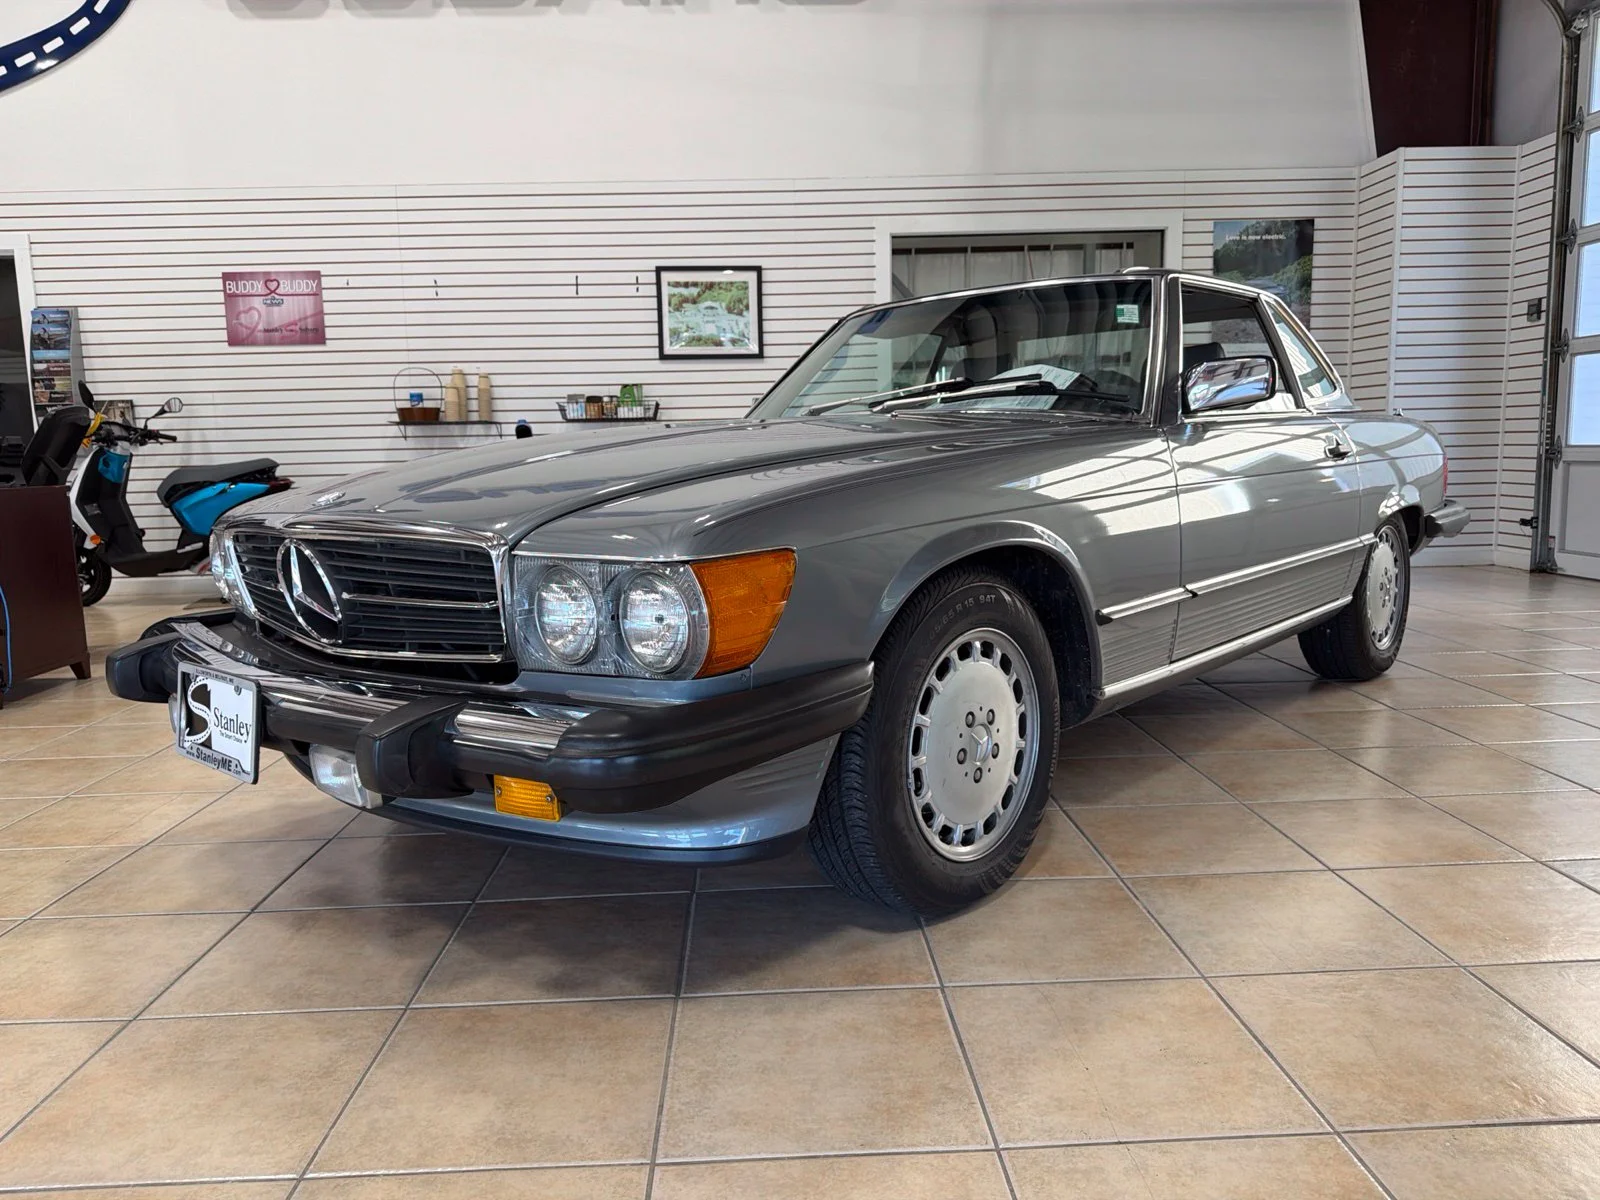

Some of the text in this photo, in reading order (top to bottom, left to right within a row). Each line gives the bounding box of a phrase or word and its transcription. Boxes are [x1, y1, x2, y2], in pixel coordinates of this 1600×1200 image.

[226, 280, 318, 294] BUDDY BUDDY
[956, 603, 964, 613] R
[964, 598, 974, 608] 15
[979, 594, 996, 604] 94T
[214, 707, 252, 744] Stanley
